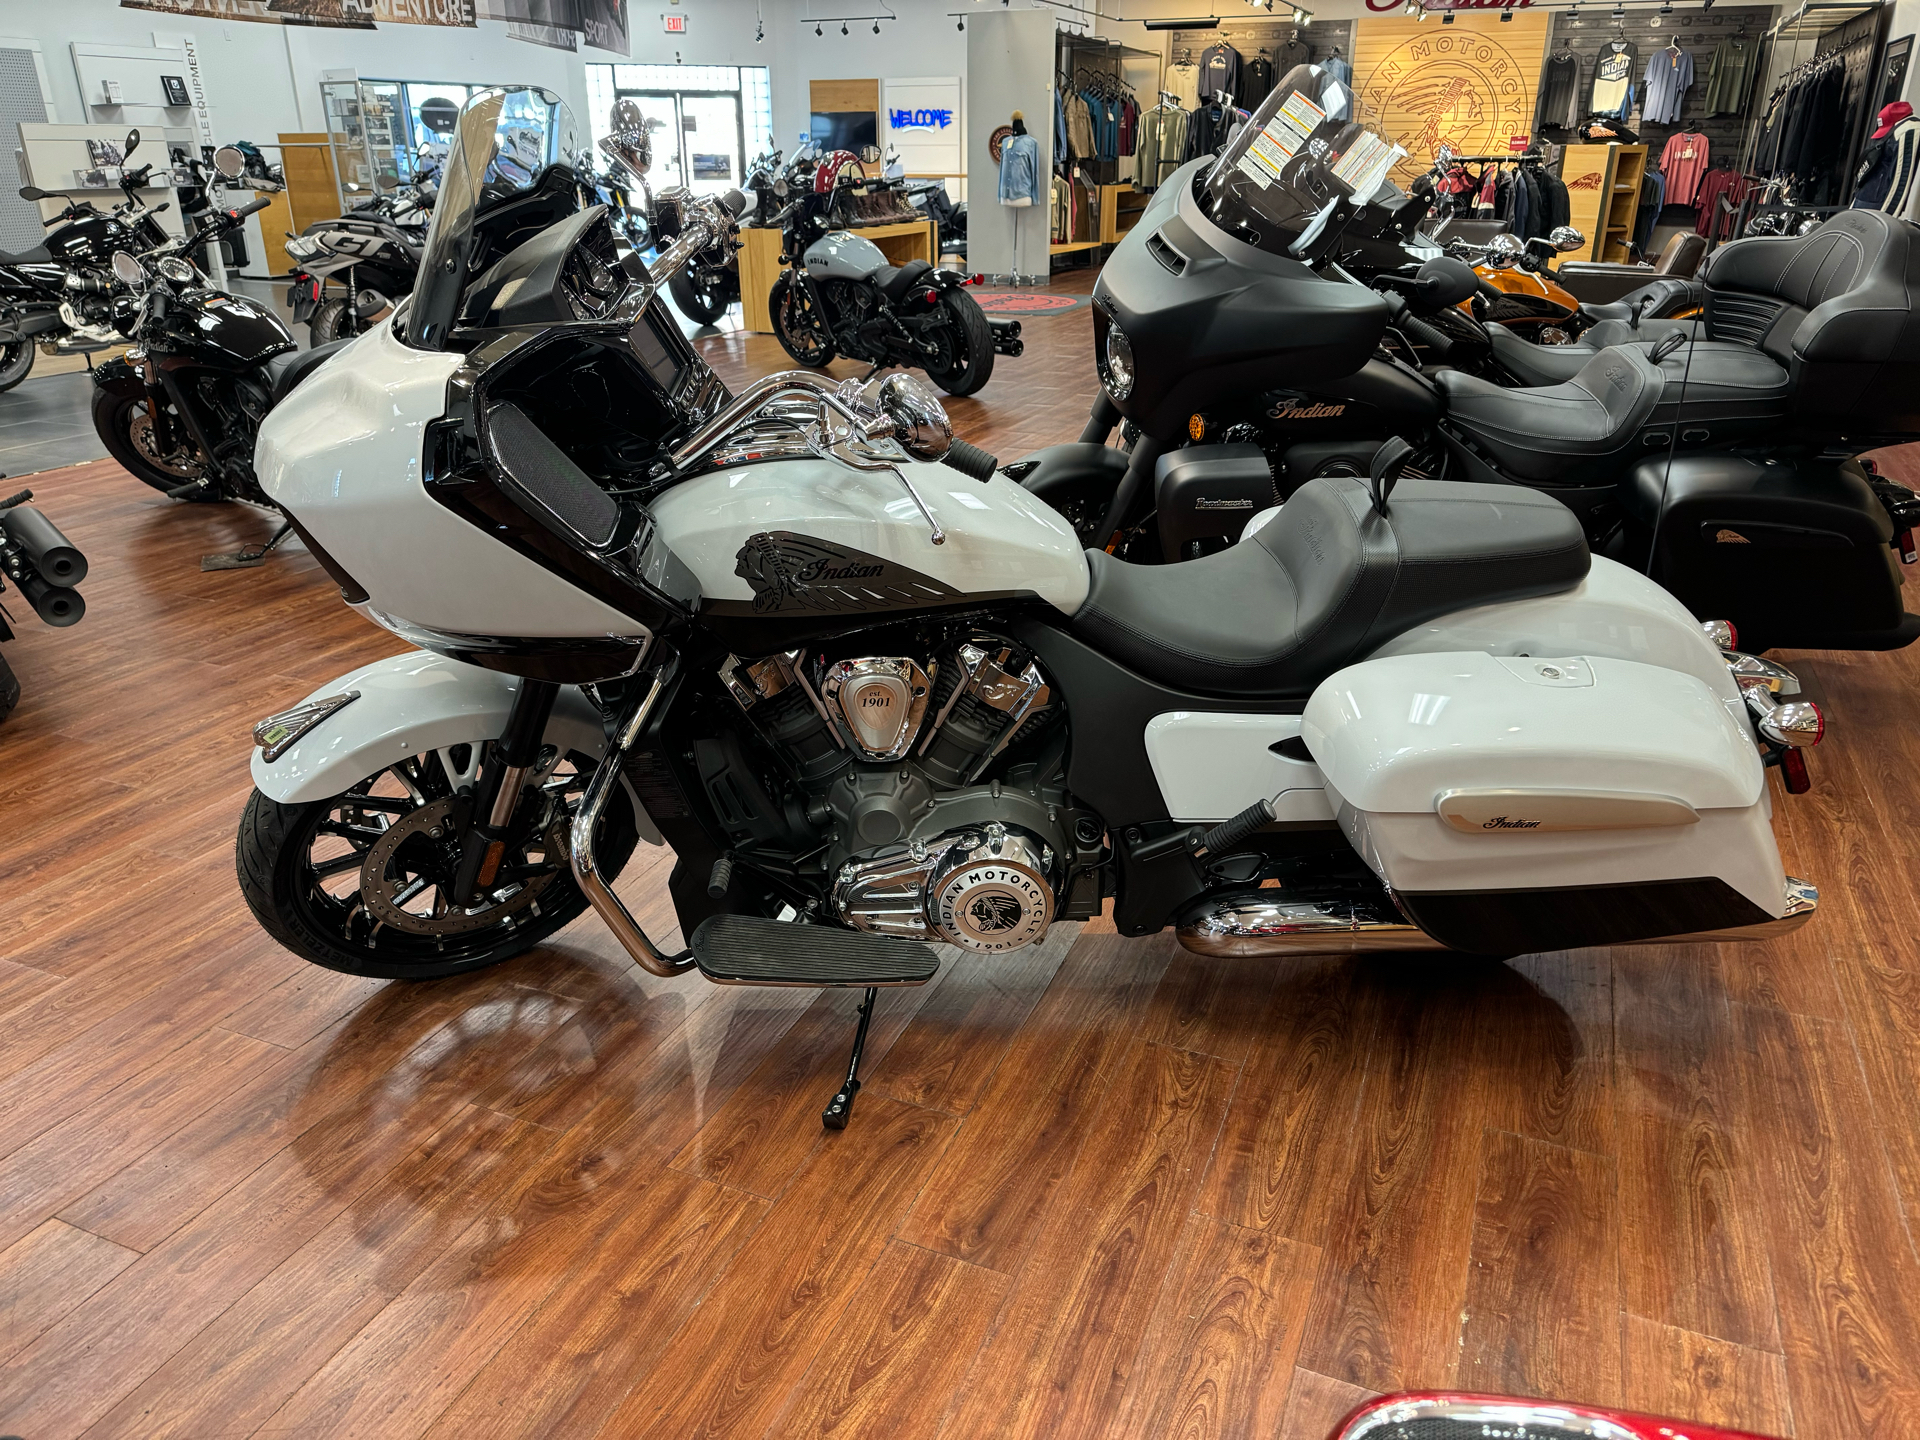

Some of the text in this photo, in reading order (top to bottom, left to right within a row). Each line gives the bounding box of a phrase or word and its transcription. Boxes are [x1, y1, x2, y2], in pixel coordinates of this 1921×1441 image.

[585, 18, 608, 44] SPORT
[667, 17, 682, 31] EXIT
[184, 39, 208, 118] EQUIPMENT
[1411, 36, 1521, 153] MOTORCYCL
[889, 108, 953, 130] WELCOME
[806, 257, 829, 267] INDIAN
[1266, 398, 1346, 419] Indian
[798, 558, 884, 582] Indian
[861, 697, 891, 709] 1901
[868, 690, 883, 698] est.
[1483, 815, 1541, 829] Indian
[552, 832, 570, 861] brembo
[942, 870, 1044, 937] INDIAN MOTORCYCLE
[289, 918, 355, 967] METZELER
[975, 941, 1012, 950] 1901
